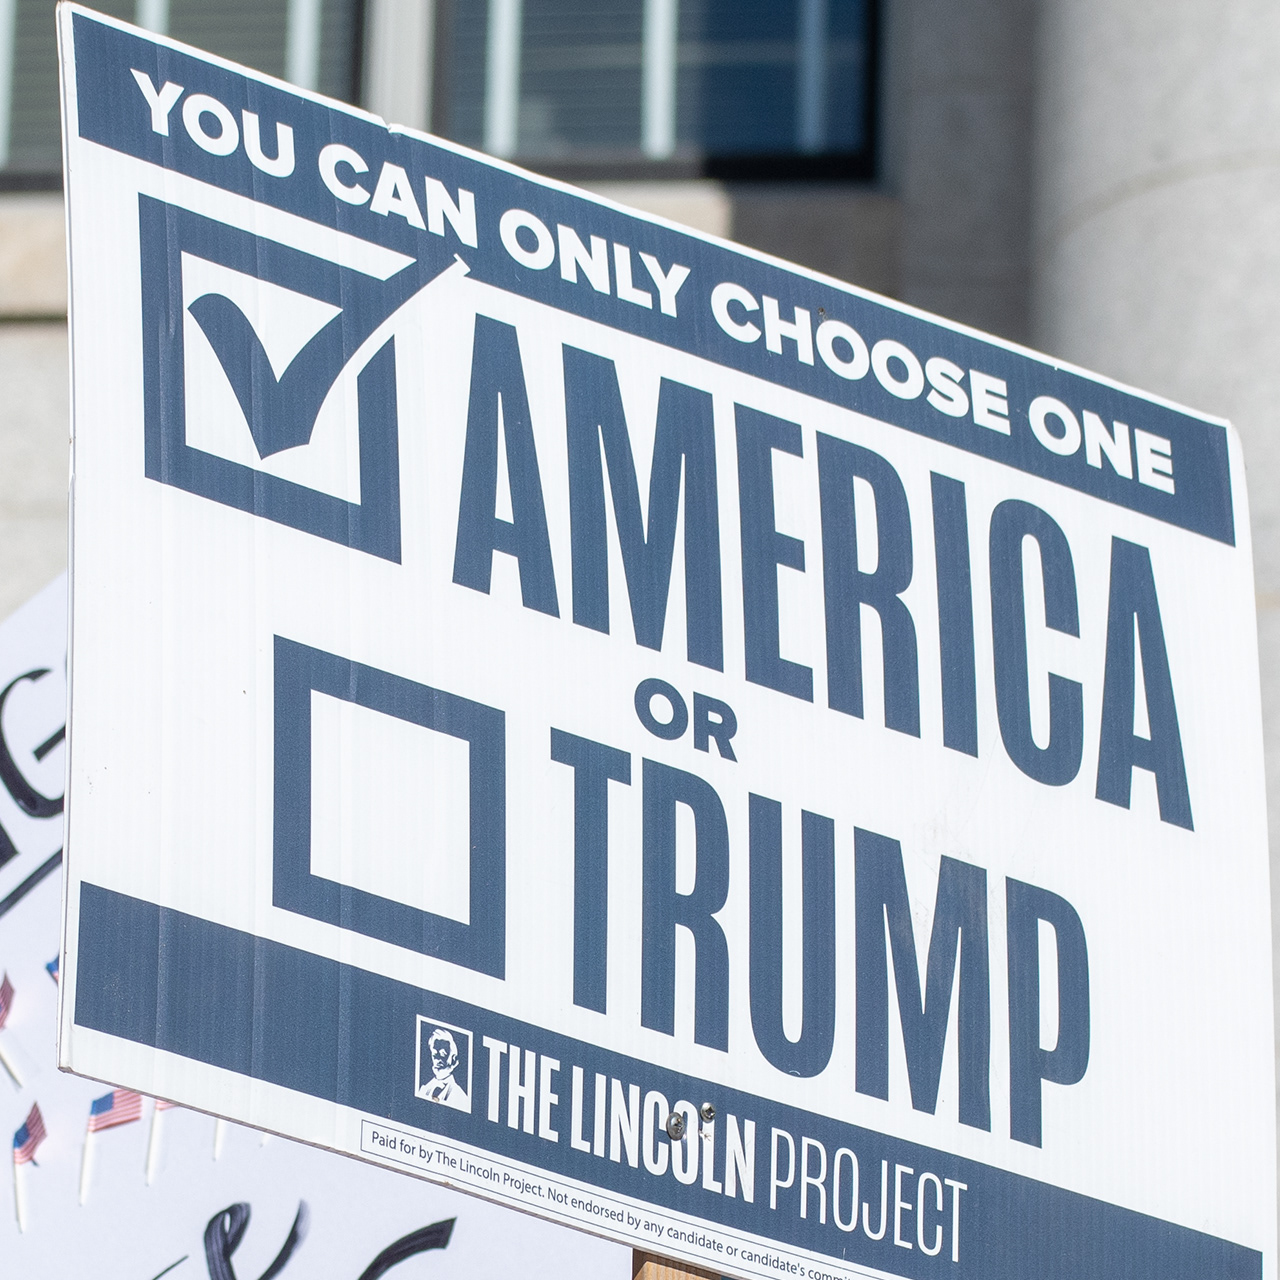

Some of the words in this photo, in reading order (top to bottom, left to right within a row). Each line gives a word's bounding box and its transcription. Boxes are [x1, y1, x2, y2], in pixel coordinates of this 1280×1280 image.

[130, 68, 296, 178] YOU
[318, 144, 478, 249] CAN
[499, 209, 691, 318] ONLY
[710, 282, 1011, 435] CHOOSE
[1029, 396, 1176, 494] ONE
[453, 312, 1195, 832] AMERICA
[634, 678, 738, 763] OR
[550, 727, 1091, 1148] TRUMP
[371, 1130, 397, 1150] Paid
[399, 1140, 416, 1155] for
[419, 1145, 433, 1164] by
[435, 1150, 457, 1169] The
[459, 1157, 500, 1183] Lincoln
[503, 1172, 545, 1198] Project.
[547, 1187, 569, 1206] Not
[570, 1197, 624, 1223] endorsed
[627, 1212, 641, 1230] by
[643, 1219, 664, 1238] any
[667, 1226, 724, 1253] candidate
[726, 1246, 739, 1257] or
[740, 1251, 806, 1277] candidate's
[482, 1036, 559, 1142] THE
[571, 1065, 756, 1204] LINCOLN
[770, 1126, 968, 1263] PROJECT
